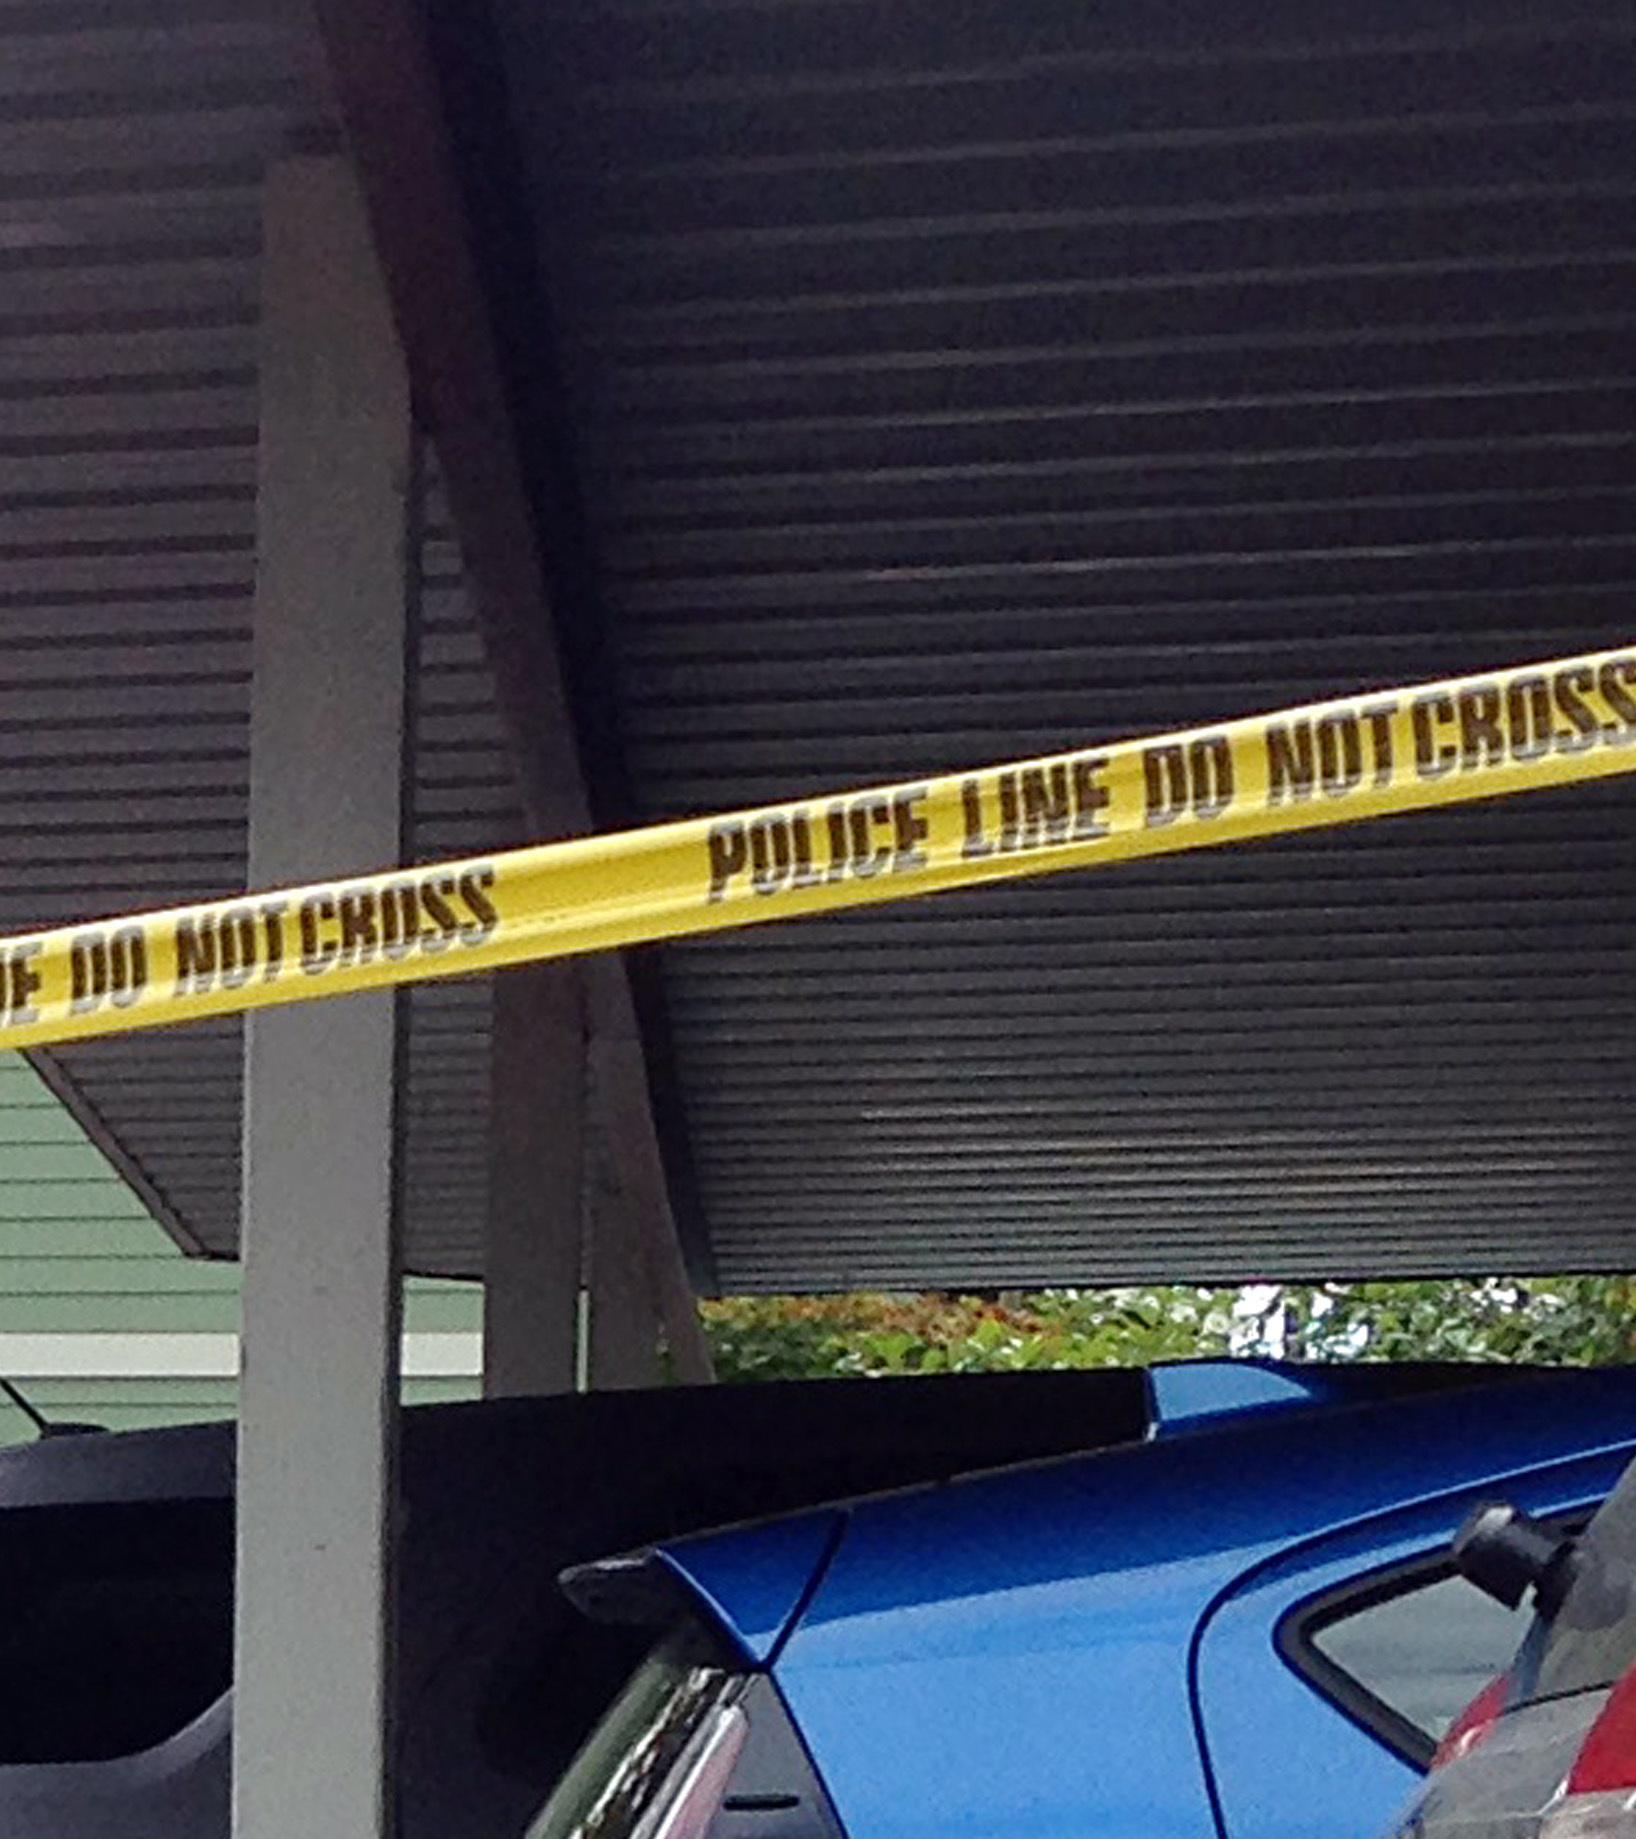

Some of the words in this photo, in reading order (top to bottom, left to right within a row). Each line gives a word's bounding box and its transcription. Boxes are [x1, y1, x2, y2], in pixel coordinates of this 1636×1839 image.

[705, 787, 930, 904] POLICE
[959, 756, 1110, 860] LINE
[1142, 734, 1234, 828] DO
[1264, 699, 1398, 809] NOT
[70, 924, 147, 1015] DO
[174, 900, 289, 998] NOT
[298, 865, 498, 974] CROSS
